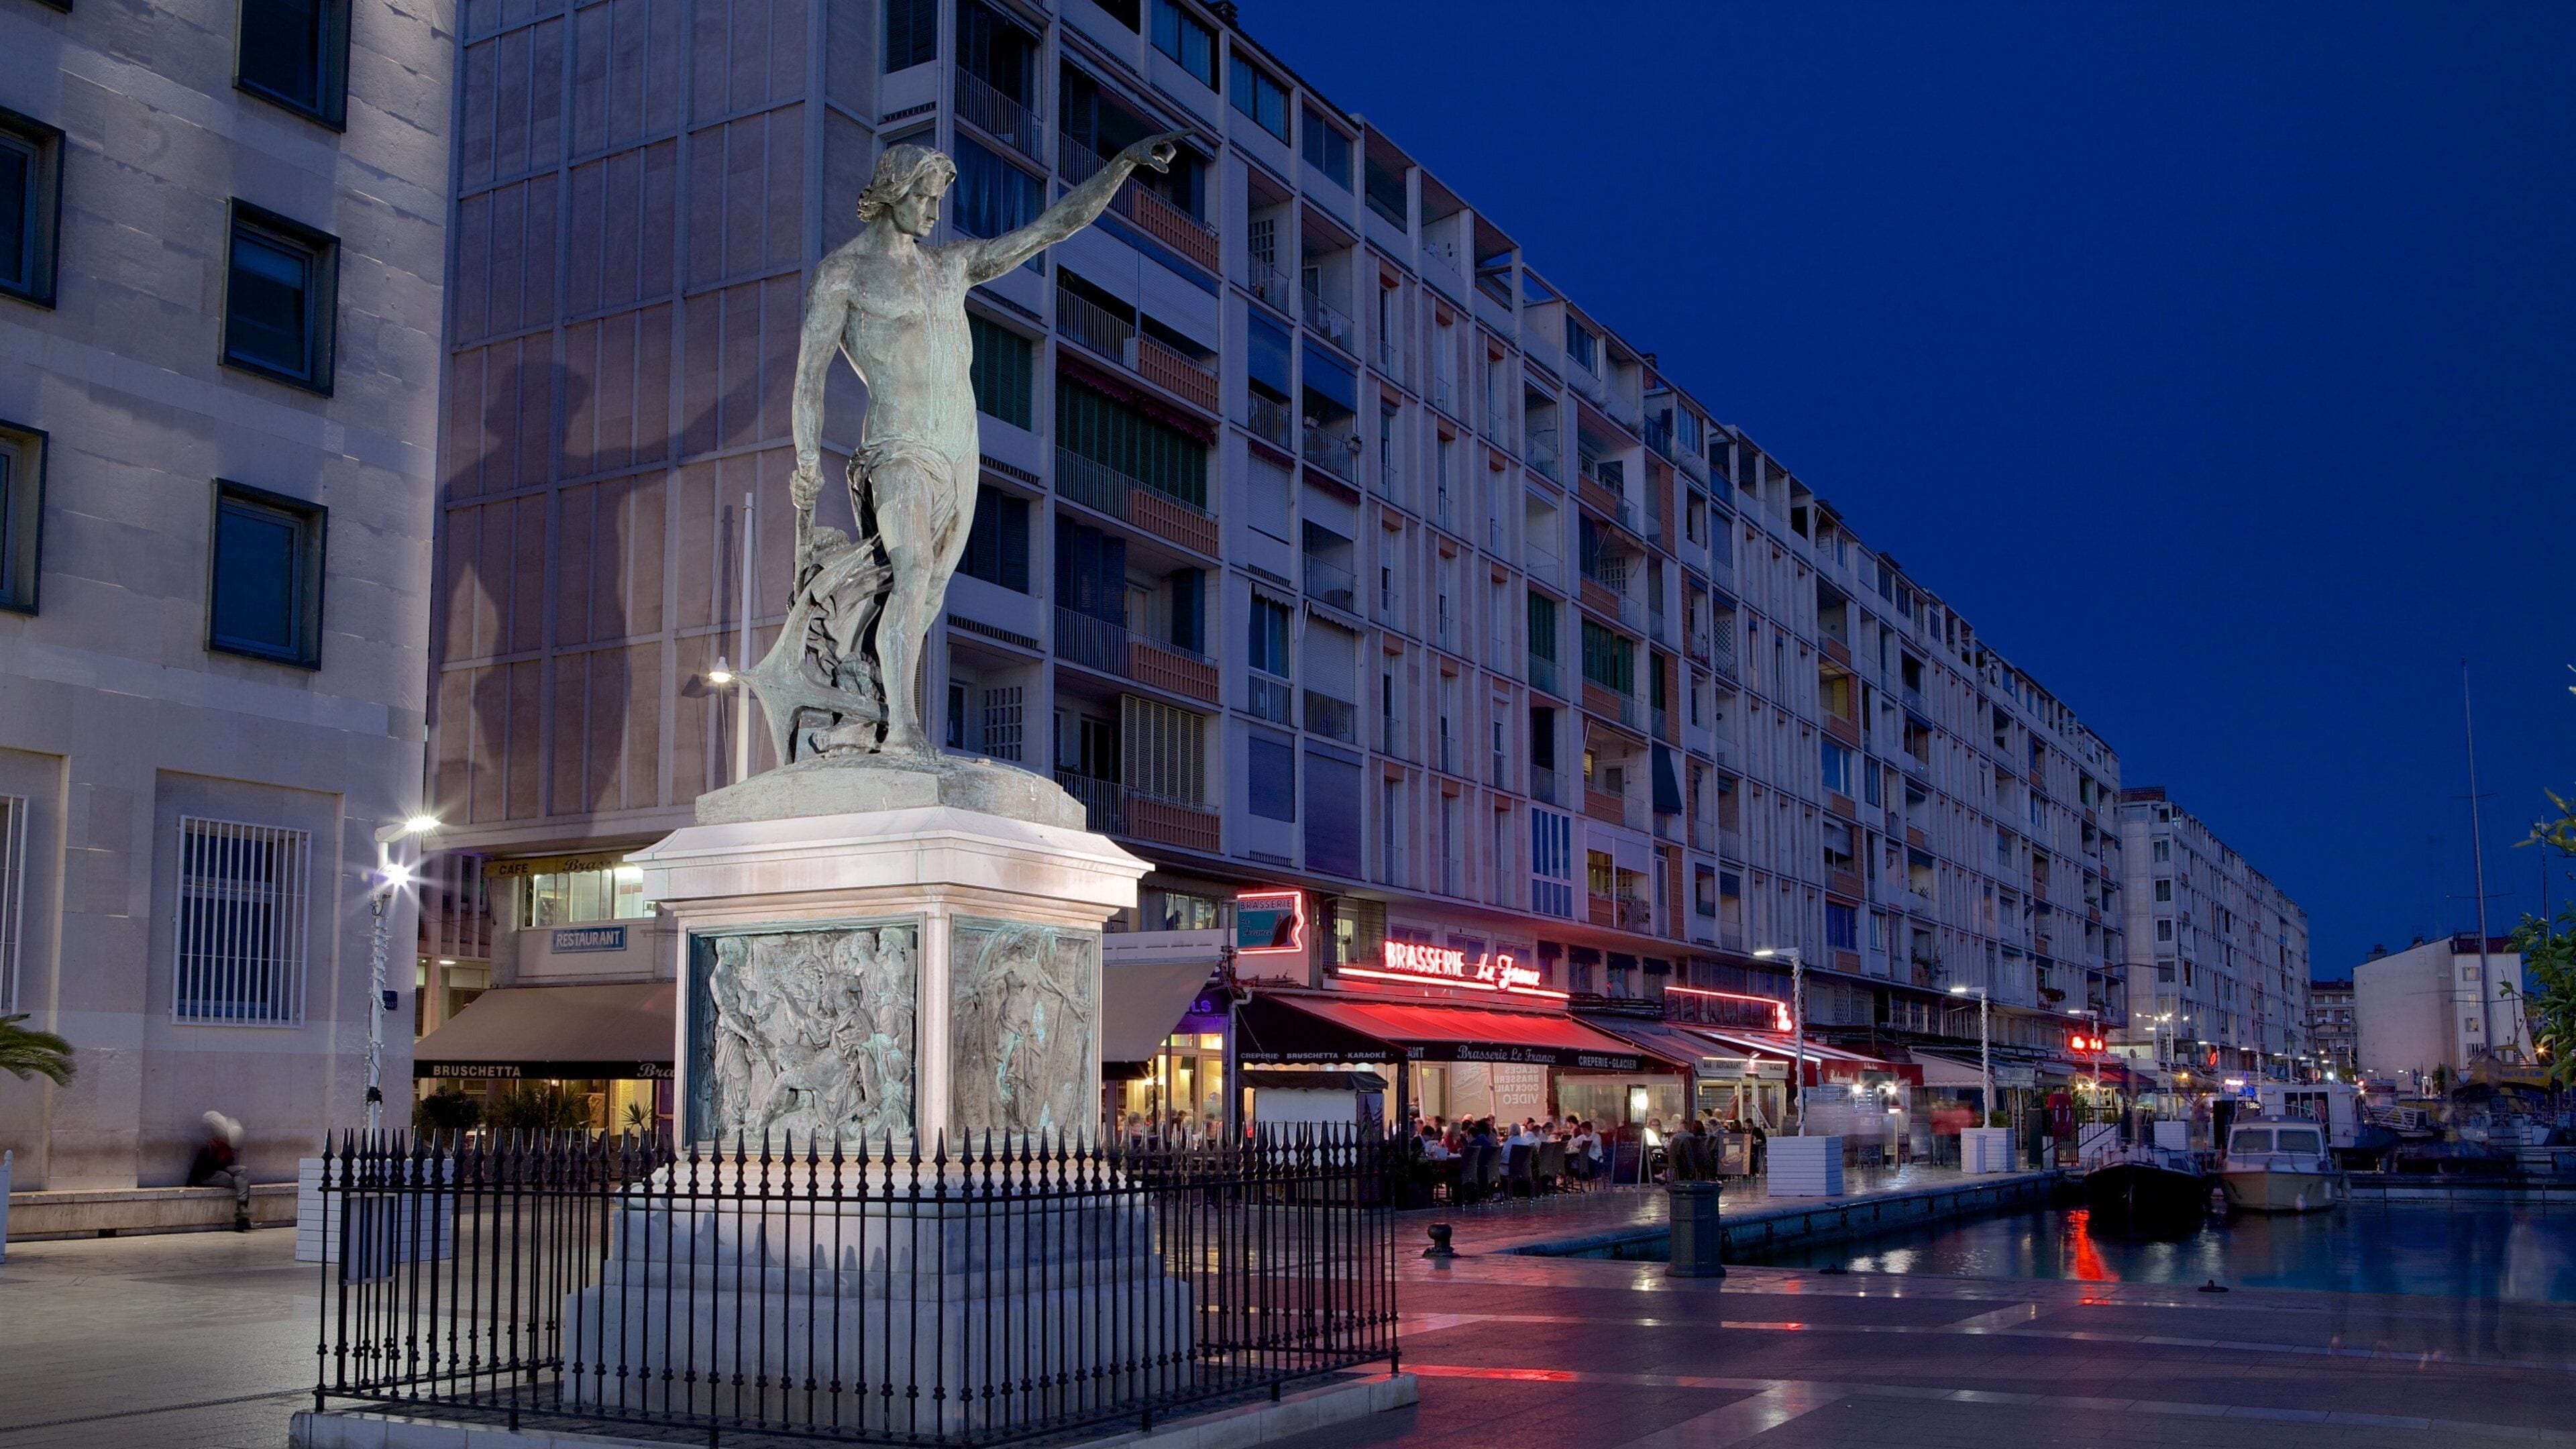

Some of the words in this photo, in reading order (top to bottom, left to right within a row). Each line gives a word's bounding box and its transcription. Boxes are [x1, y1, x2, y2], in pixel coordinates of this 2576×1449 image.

[1240, 899, 1292, 910] BRASSERIE
[556, 930, 621, 947] RESTAURANT
[1385, 941, 1465, 977] BRASSERIE
[1476, 953, 1495, 981] Le
[1457, 1044, 1508, 1061] Brasserie
[1510, 1048, 1523, 1061] Le
[1525, 1048, 1556, 1063] France
[433, 1065, 521, 1077] BRUSCHETTA
